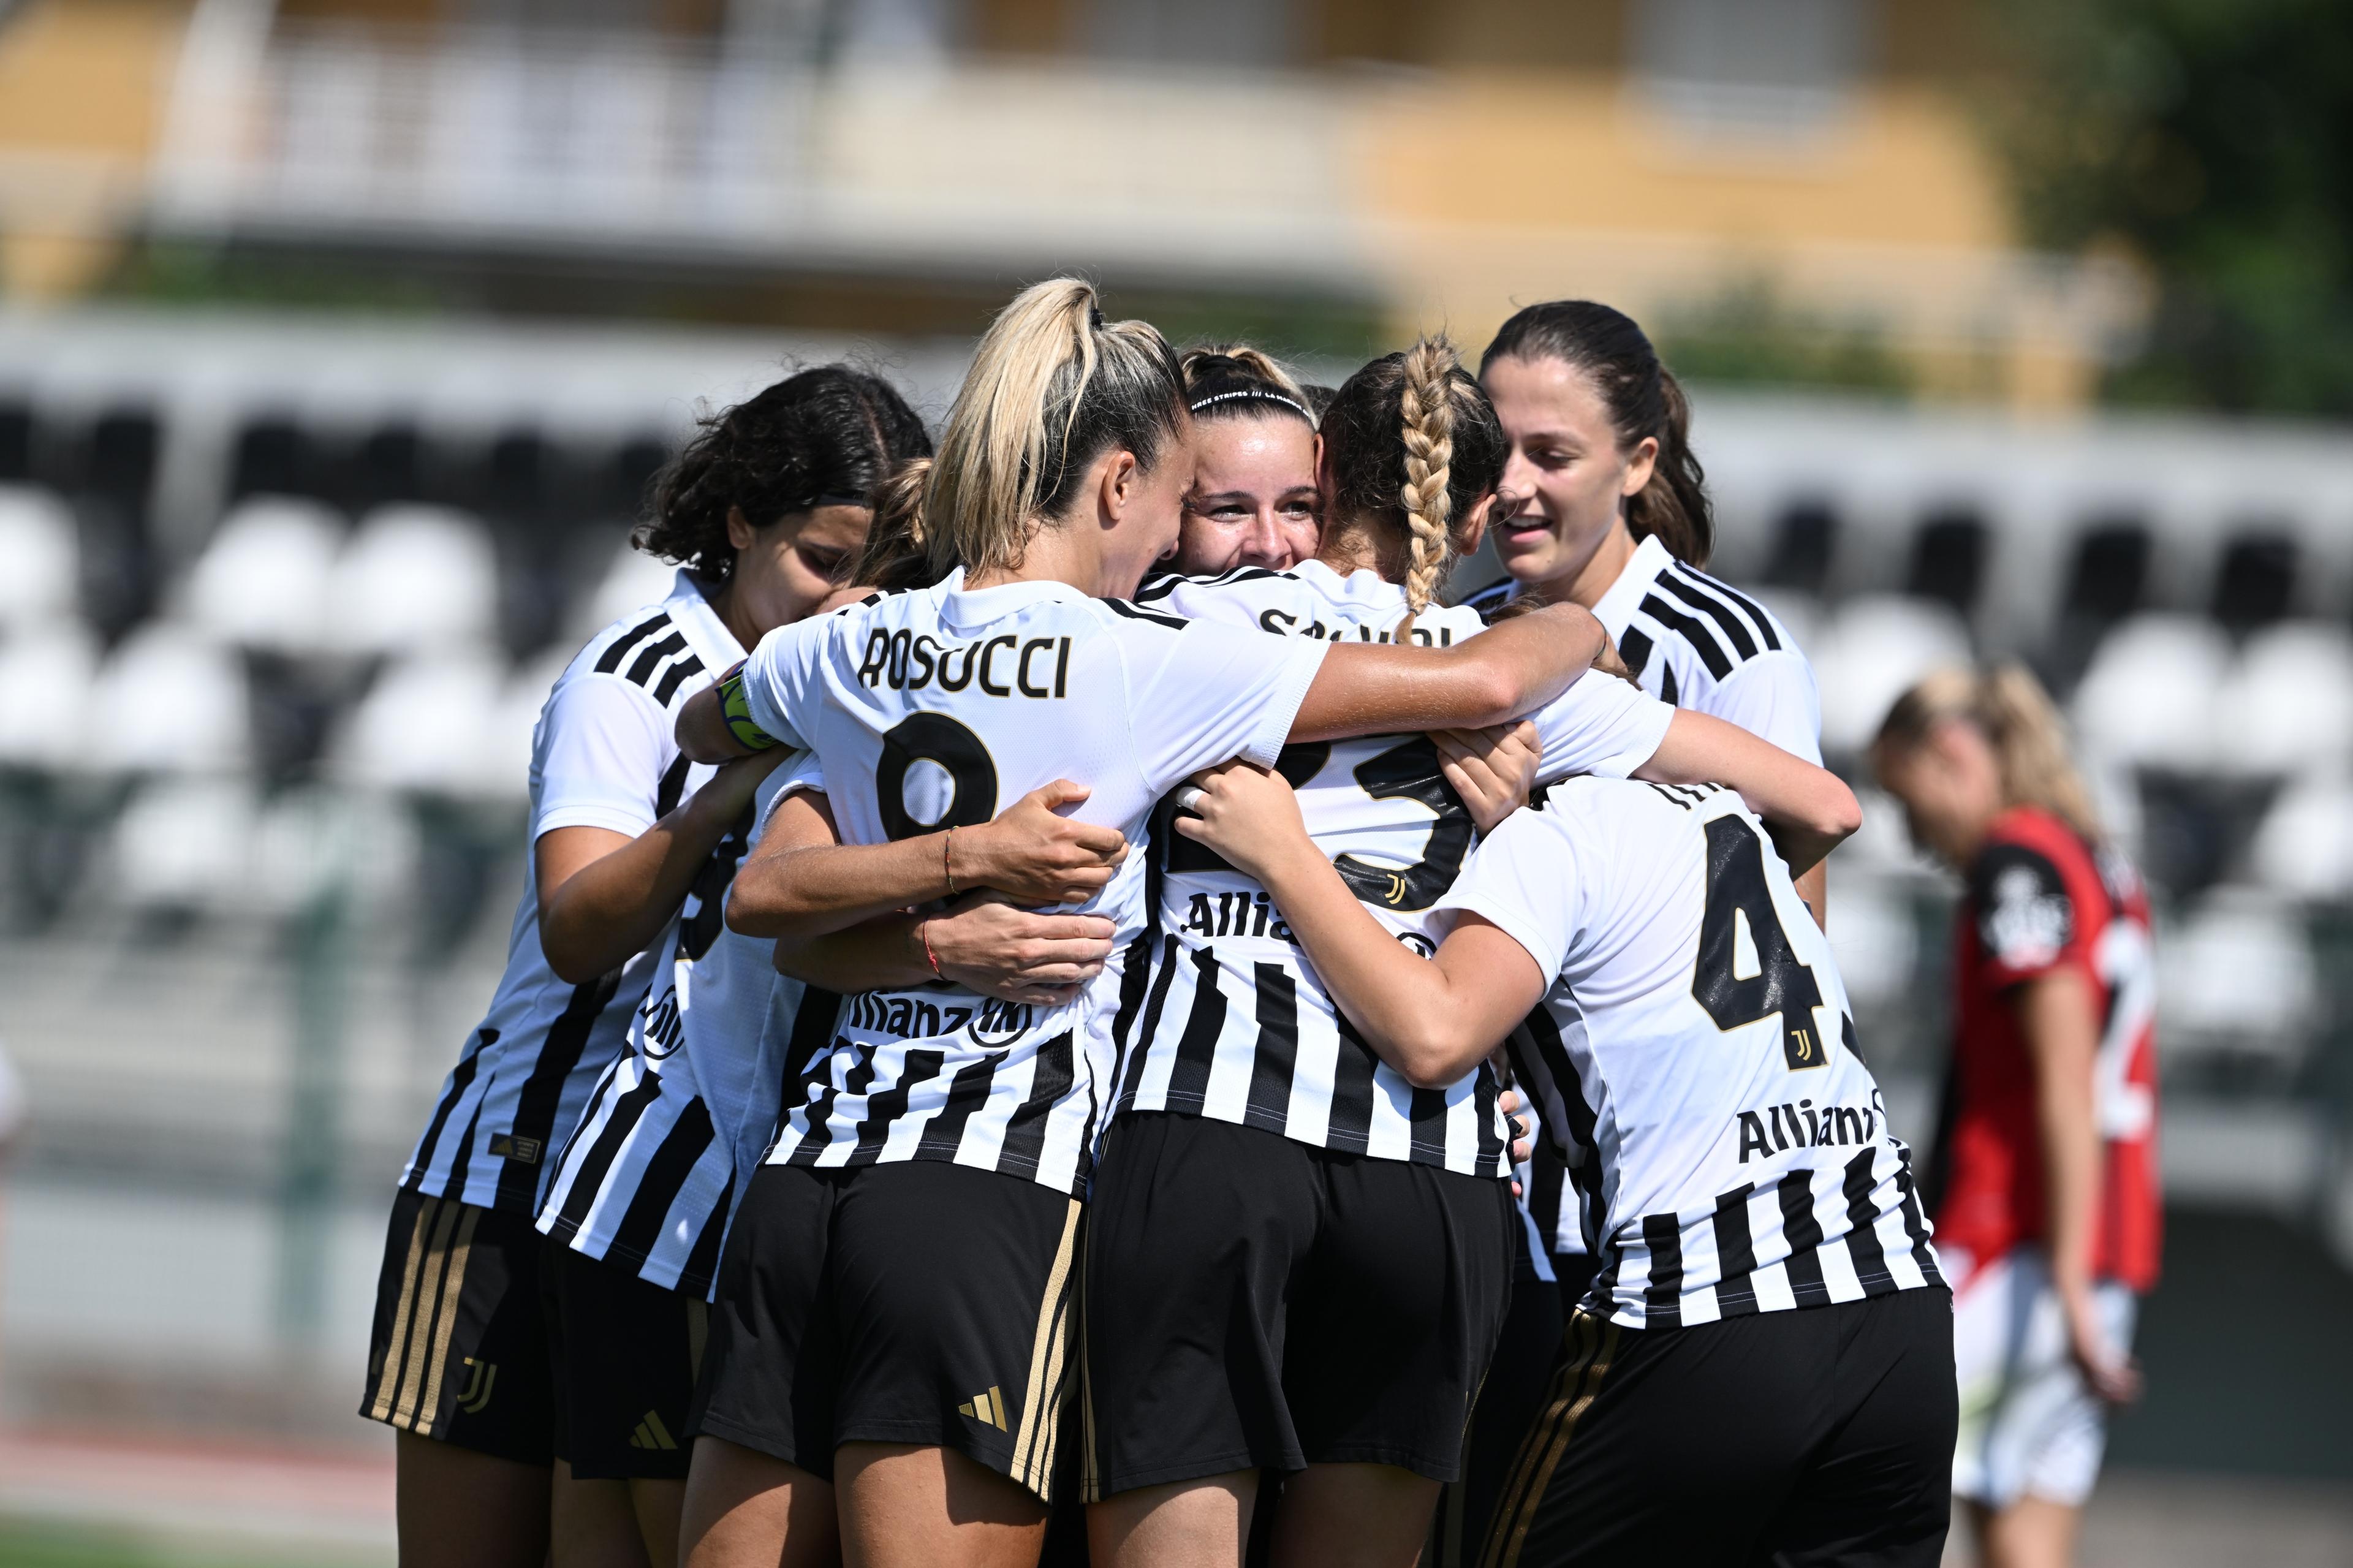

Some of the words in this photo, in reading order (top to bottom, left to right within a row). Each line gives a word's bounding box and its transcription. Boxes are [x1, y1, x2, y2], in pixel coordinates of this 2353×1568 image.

[1191, 397, 1213, 411] HREE
[1214, 391, 1248, 401] STRIPES
[858, 627, 1072, 699] ROSUCCI
[1691, 812, 1868, 1073] 4
[848, 990, 974, 1039] llianz
